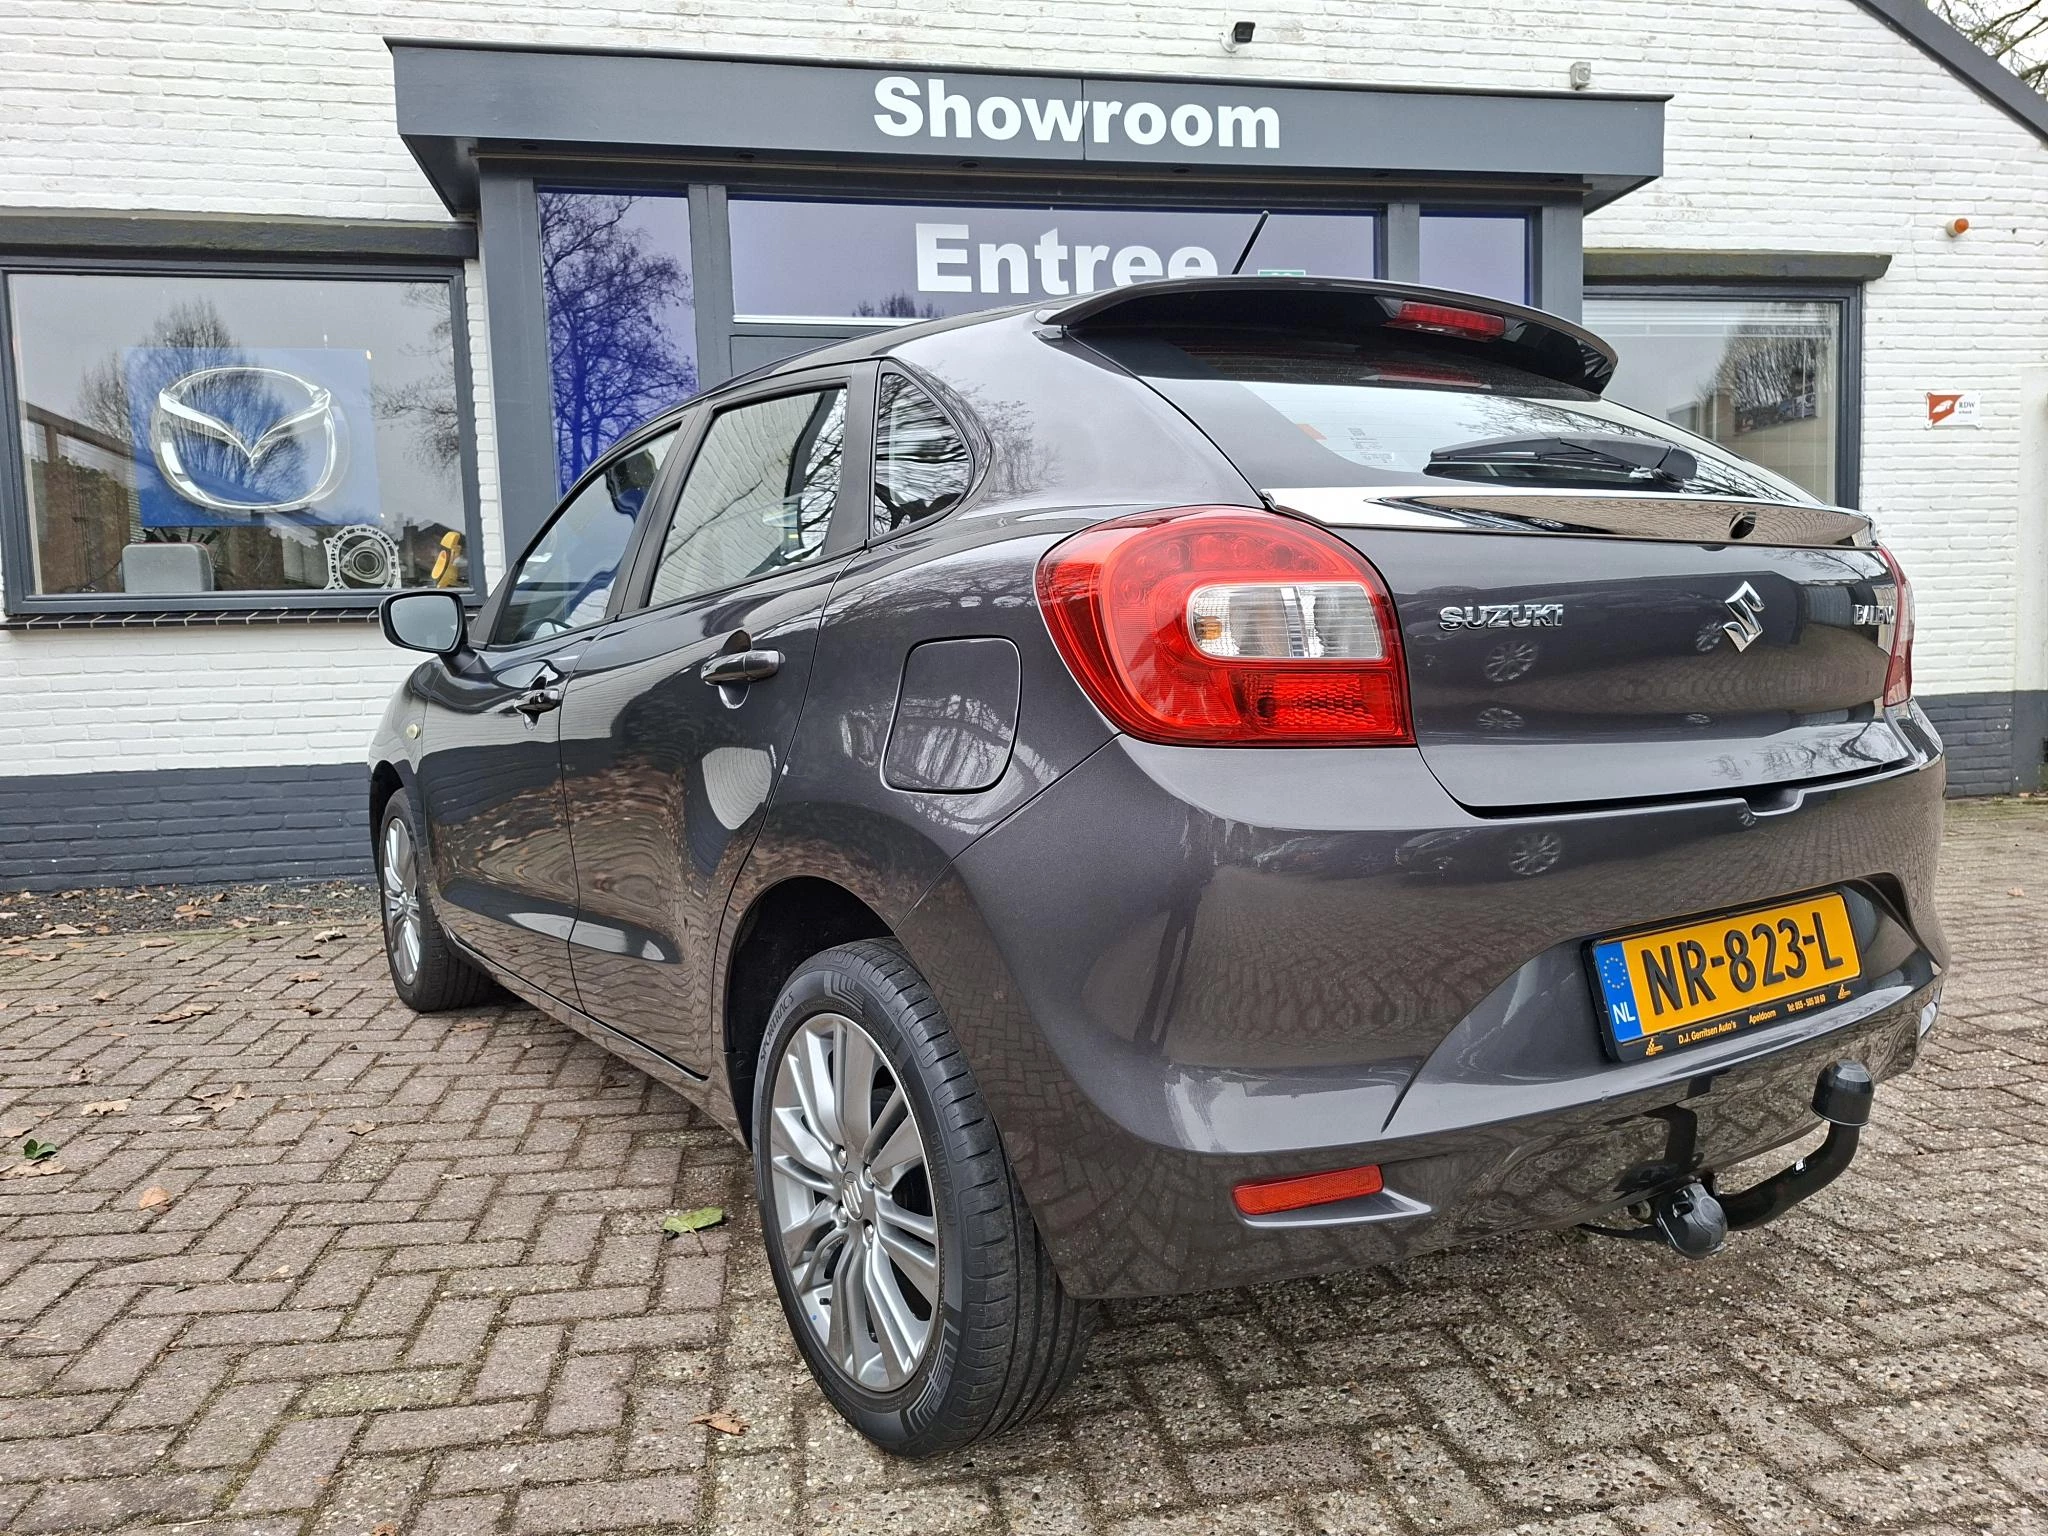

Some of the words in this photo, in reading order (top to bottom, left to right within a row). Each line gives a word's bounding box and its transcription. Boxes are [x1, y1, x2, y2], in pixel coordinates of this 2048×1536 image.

[873, 76, 1280, 149] Showroom
[915, 223, 1219, 296] Entree
[1439, 603, 1564, 631] SUZUKI
[1641, 911, 1844, 1016] NR-823-L
[1612, 1001, 1636, 1025] NL
[1678, 1032, 1691, 1045] D.J.
[1691, 1026, 1718, 1041] Gerritsen
[1718, 1020, 1737, 1034] Auto's
